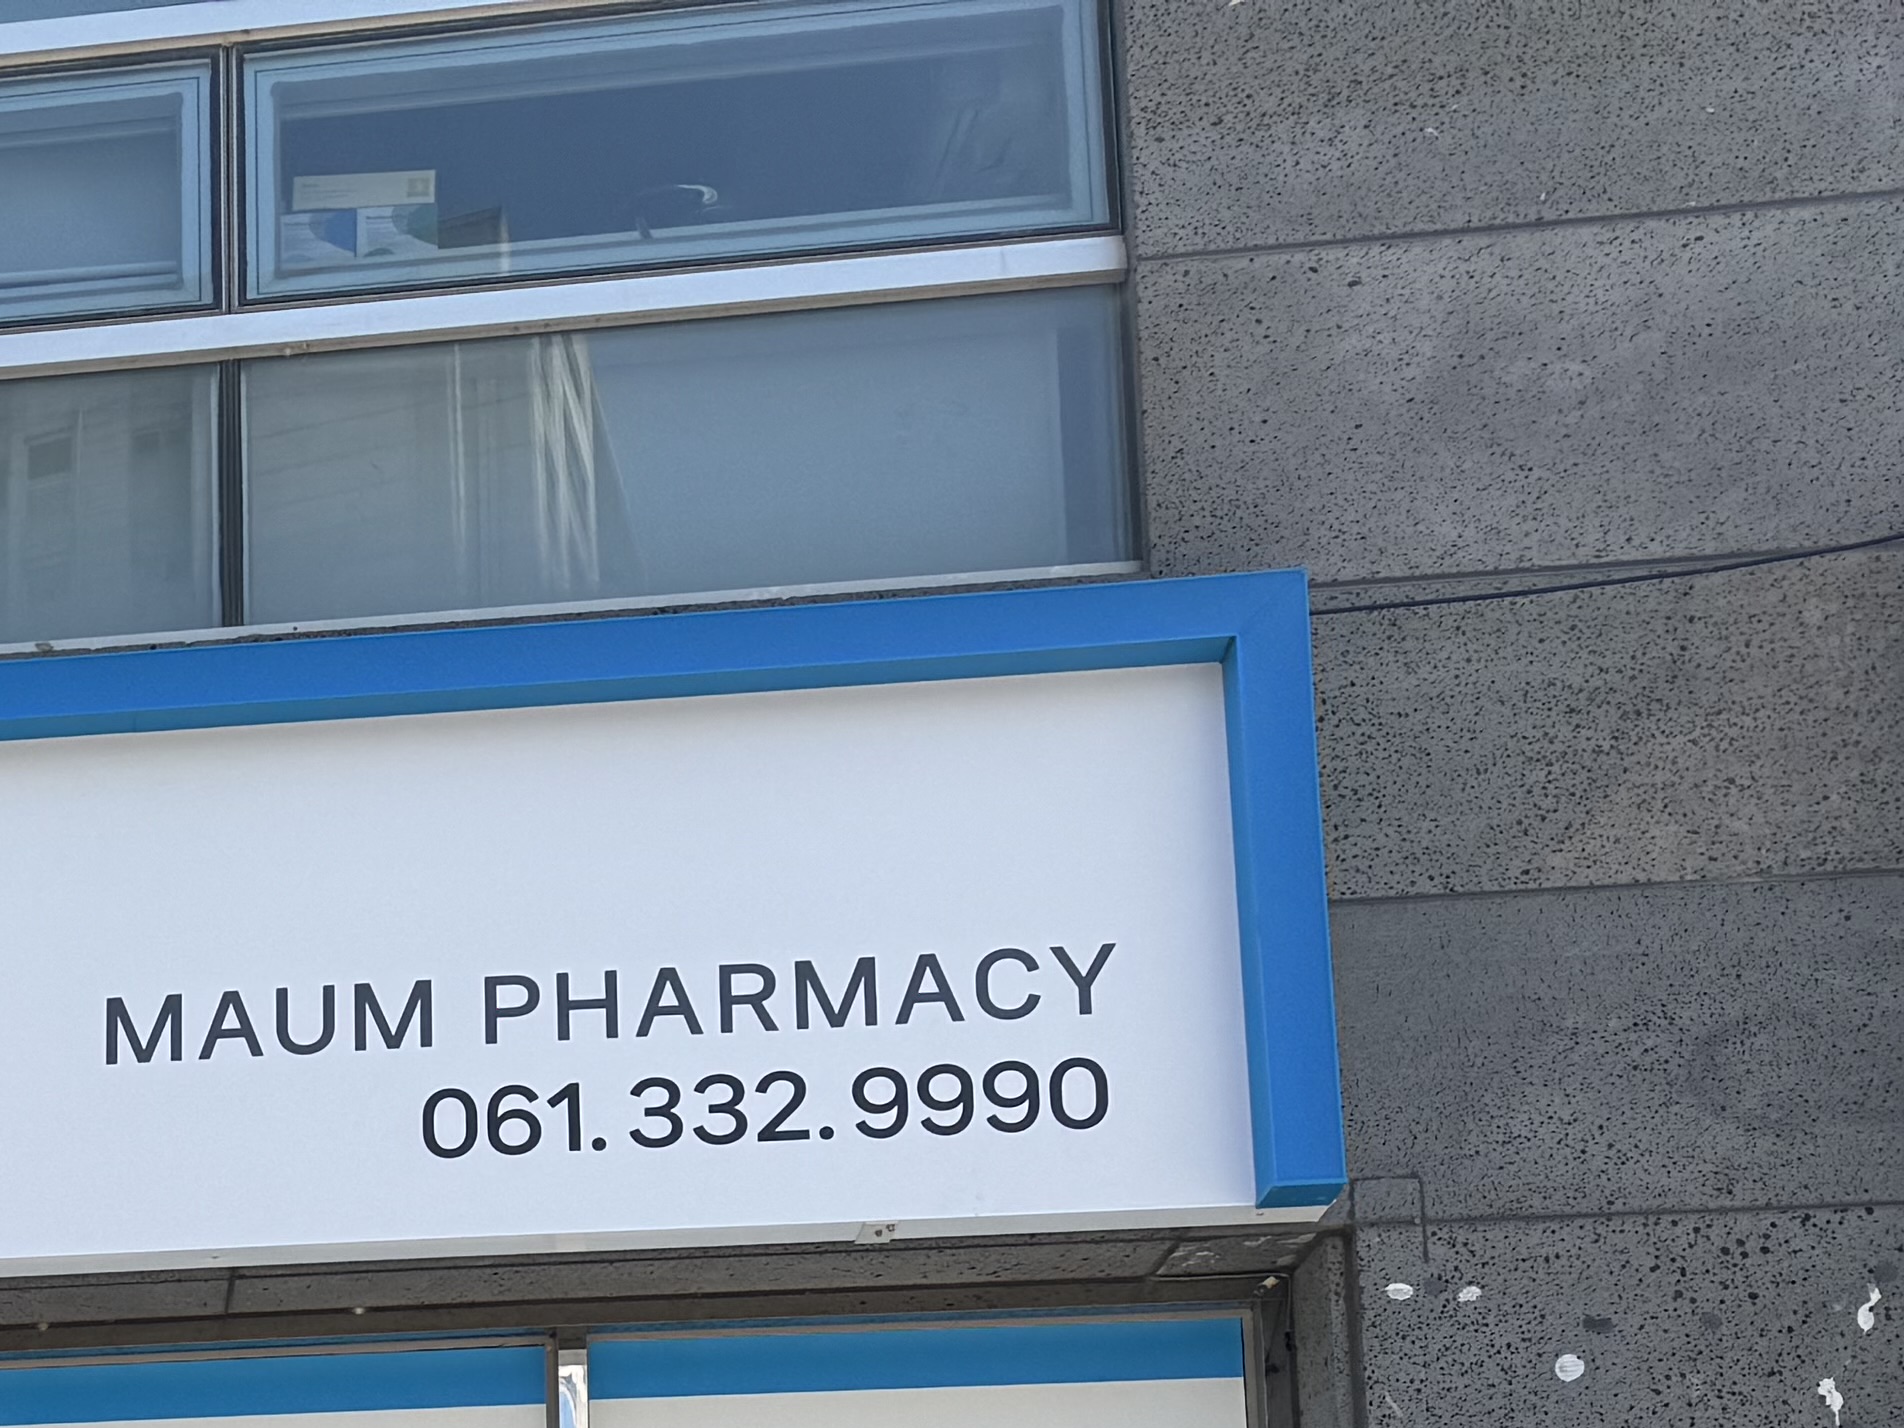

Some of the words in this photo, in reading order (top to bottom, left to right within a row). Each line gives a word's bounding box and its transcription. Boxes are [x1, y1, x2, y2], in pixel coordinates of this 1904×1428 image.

[104, 979, 435, 1065] MAUM
[484, 942, 1118, 1045] PHARMACY
[421, 1057, 1111, 1160] 061.332.9990
